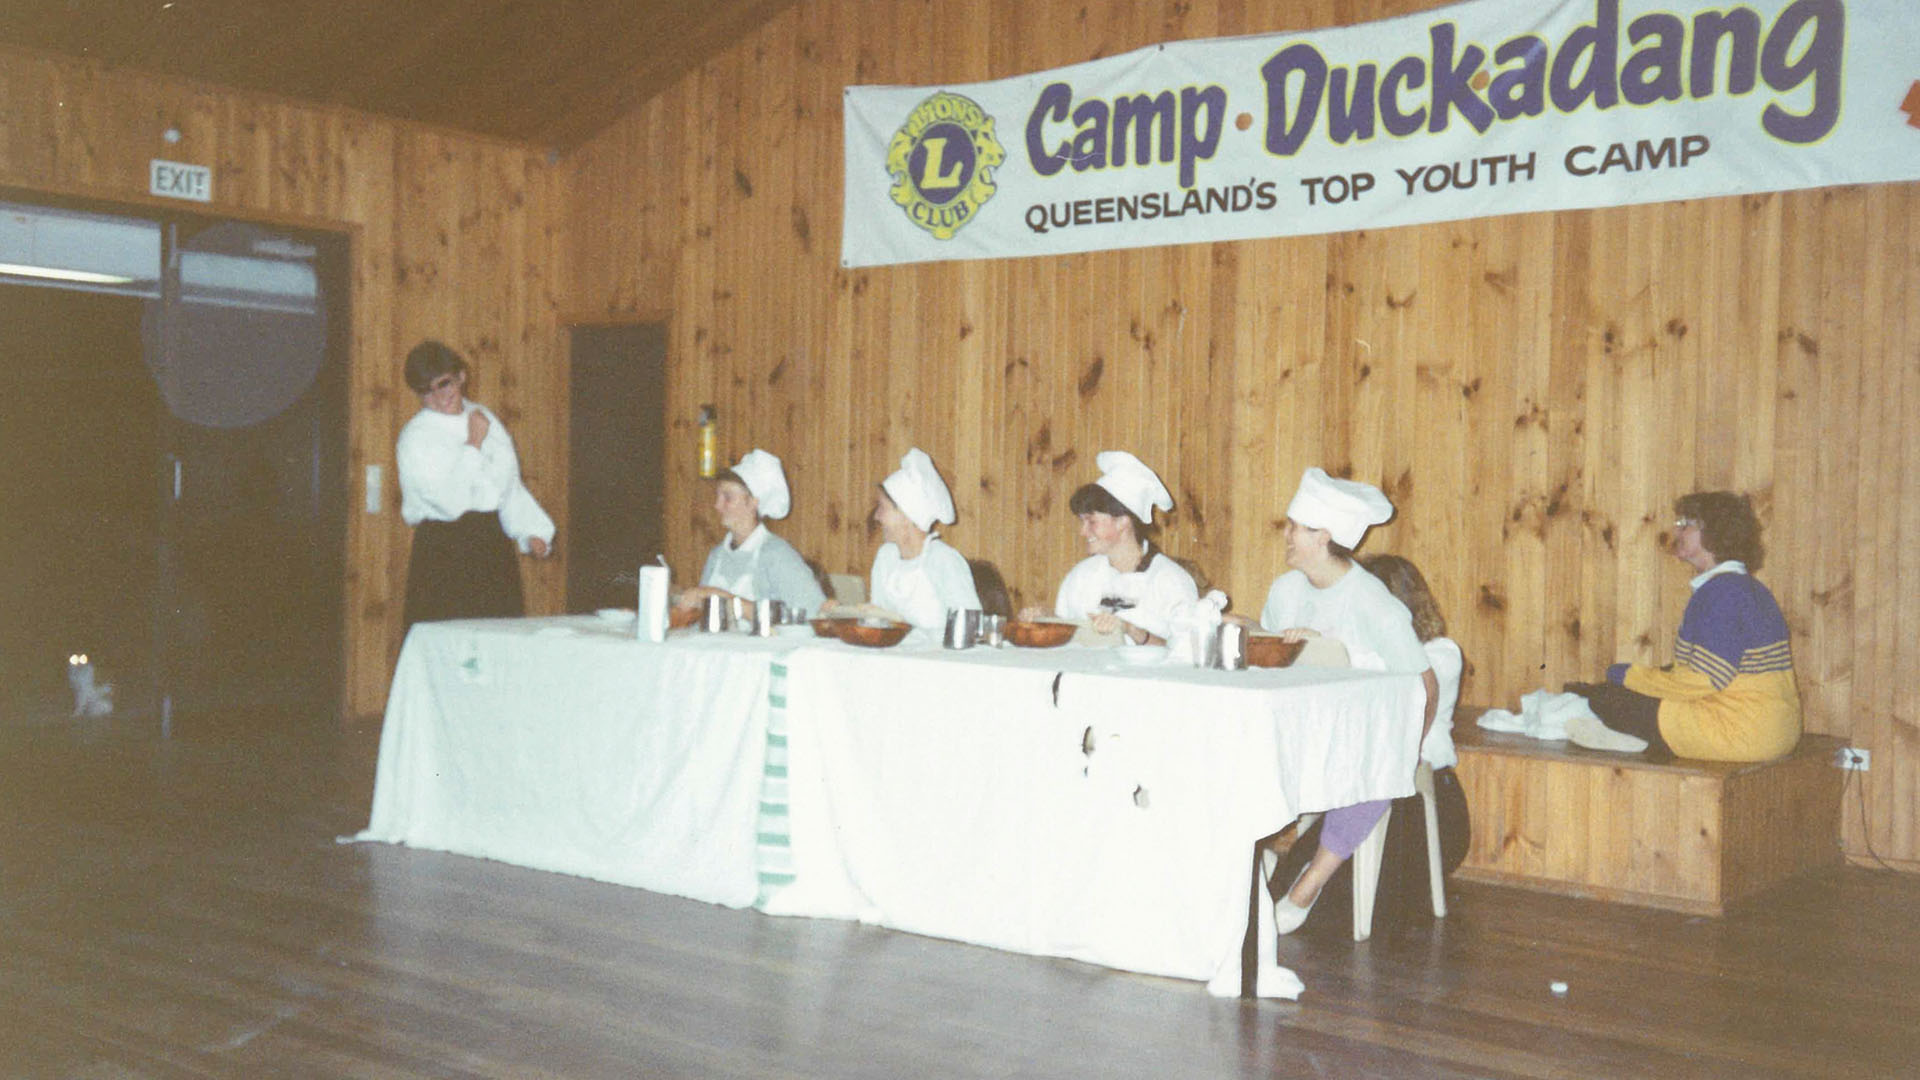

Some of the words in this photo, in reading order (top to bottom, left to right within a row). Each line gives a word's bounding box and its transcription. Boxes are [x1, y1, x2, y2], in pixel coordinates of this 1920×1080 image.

[907, 98, 982, 135] LIONS
[1024, 81, 1226, 190] Camp
[1260, 0, 1843, 156] Duckadang
[156, 166, 206, 195] EXIT
[919, 137, 964, 190] L
[1024, 176, 1278, 233] QUEENSLAND'S
[1300, 172, 1376, 206] TOP
[1396, 151, 1537, 196] YOUTH
[1564, 134, 1711, 176] CAMP
[912, 200, 969, 228] CLUB
